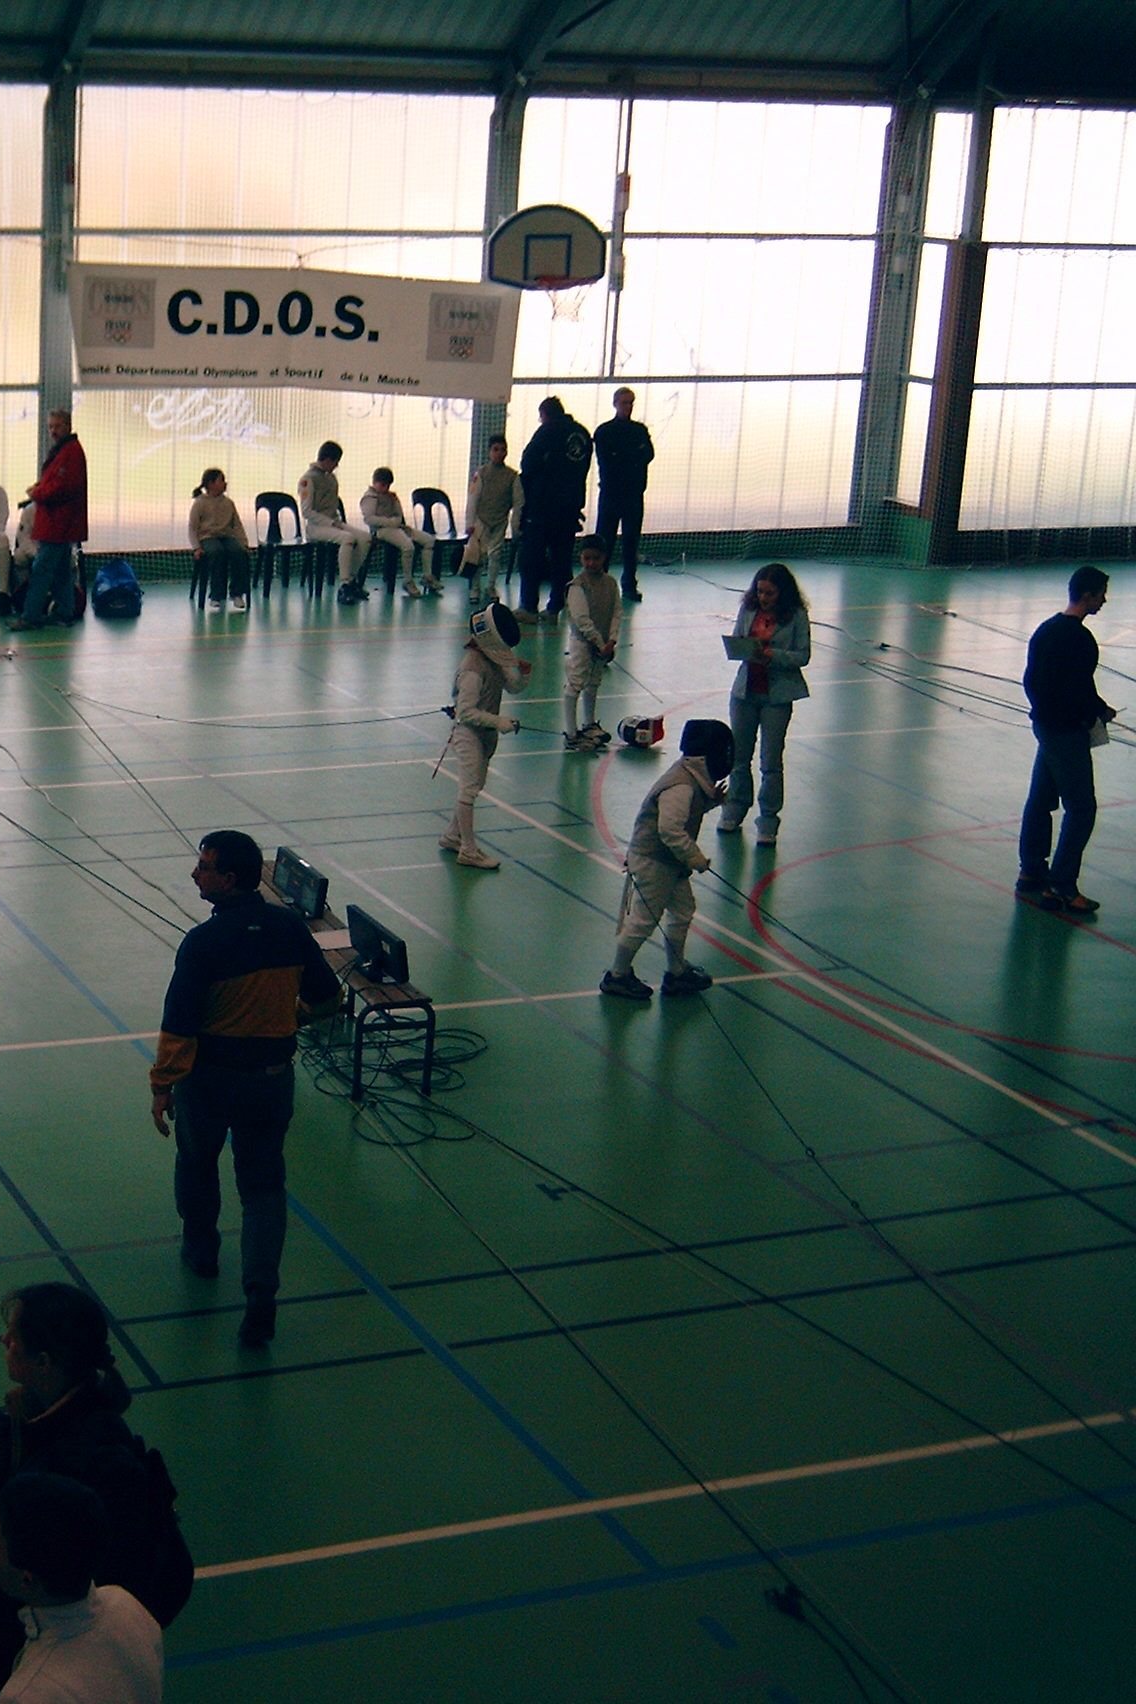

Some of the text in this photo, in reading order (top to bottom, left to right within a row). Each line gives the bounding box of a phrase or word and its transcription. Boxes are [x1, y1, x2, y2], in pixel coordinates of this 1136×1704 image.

[167, 289, 380, 342] C.D.O.S.
[79, 363, 110, 375] omité
[116, 364, 198, 377] Départemental
[203, 366, 258, 379] Olympique
[284, 367, 324, 380] Sportif
[340, 371, 353, 381] de
[359, 372, 369, 383] la
[377, 374, 421, 387] Manche
